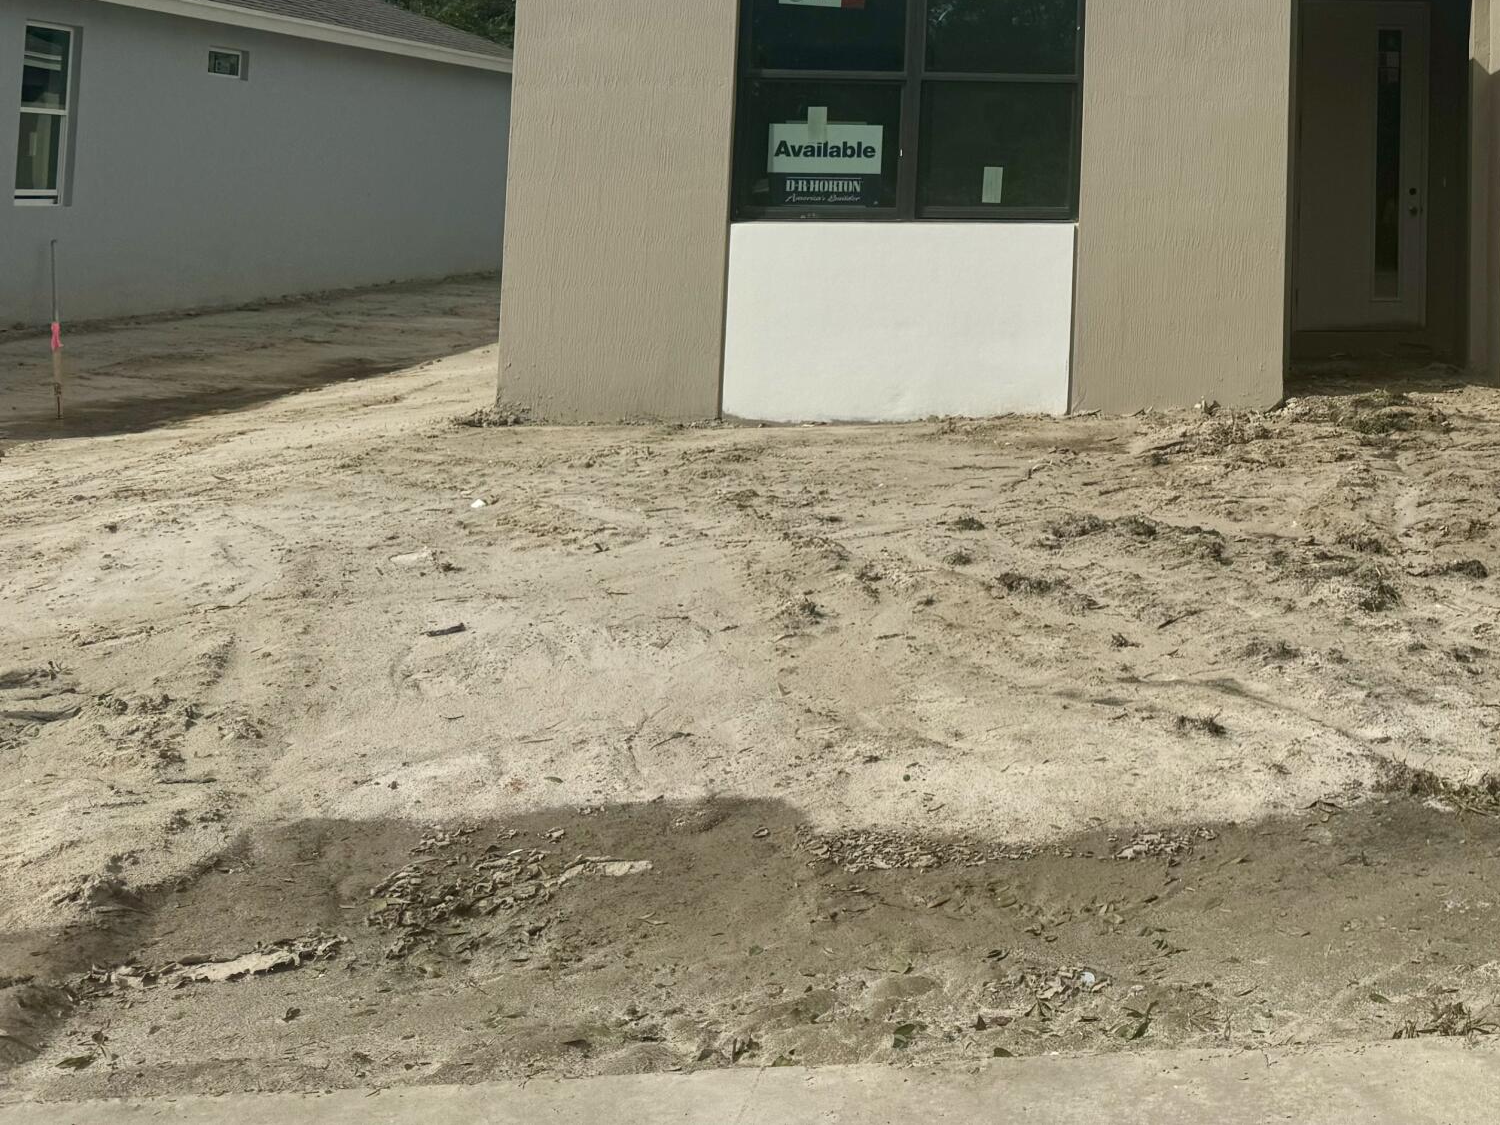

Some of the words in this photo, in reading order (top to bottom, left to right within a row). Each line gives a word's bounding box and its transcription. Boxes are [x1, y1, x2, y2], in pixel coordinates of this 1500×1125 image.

[774, 140, 876, 158] Available
[785, 193, 825, 203] America's
[827, 194, 861, 203] Builder
